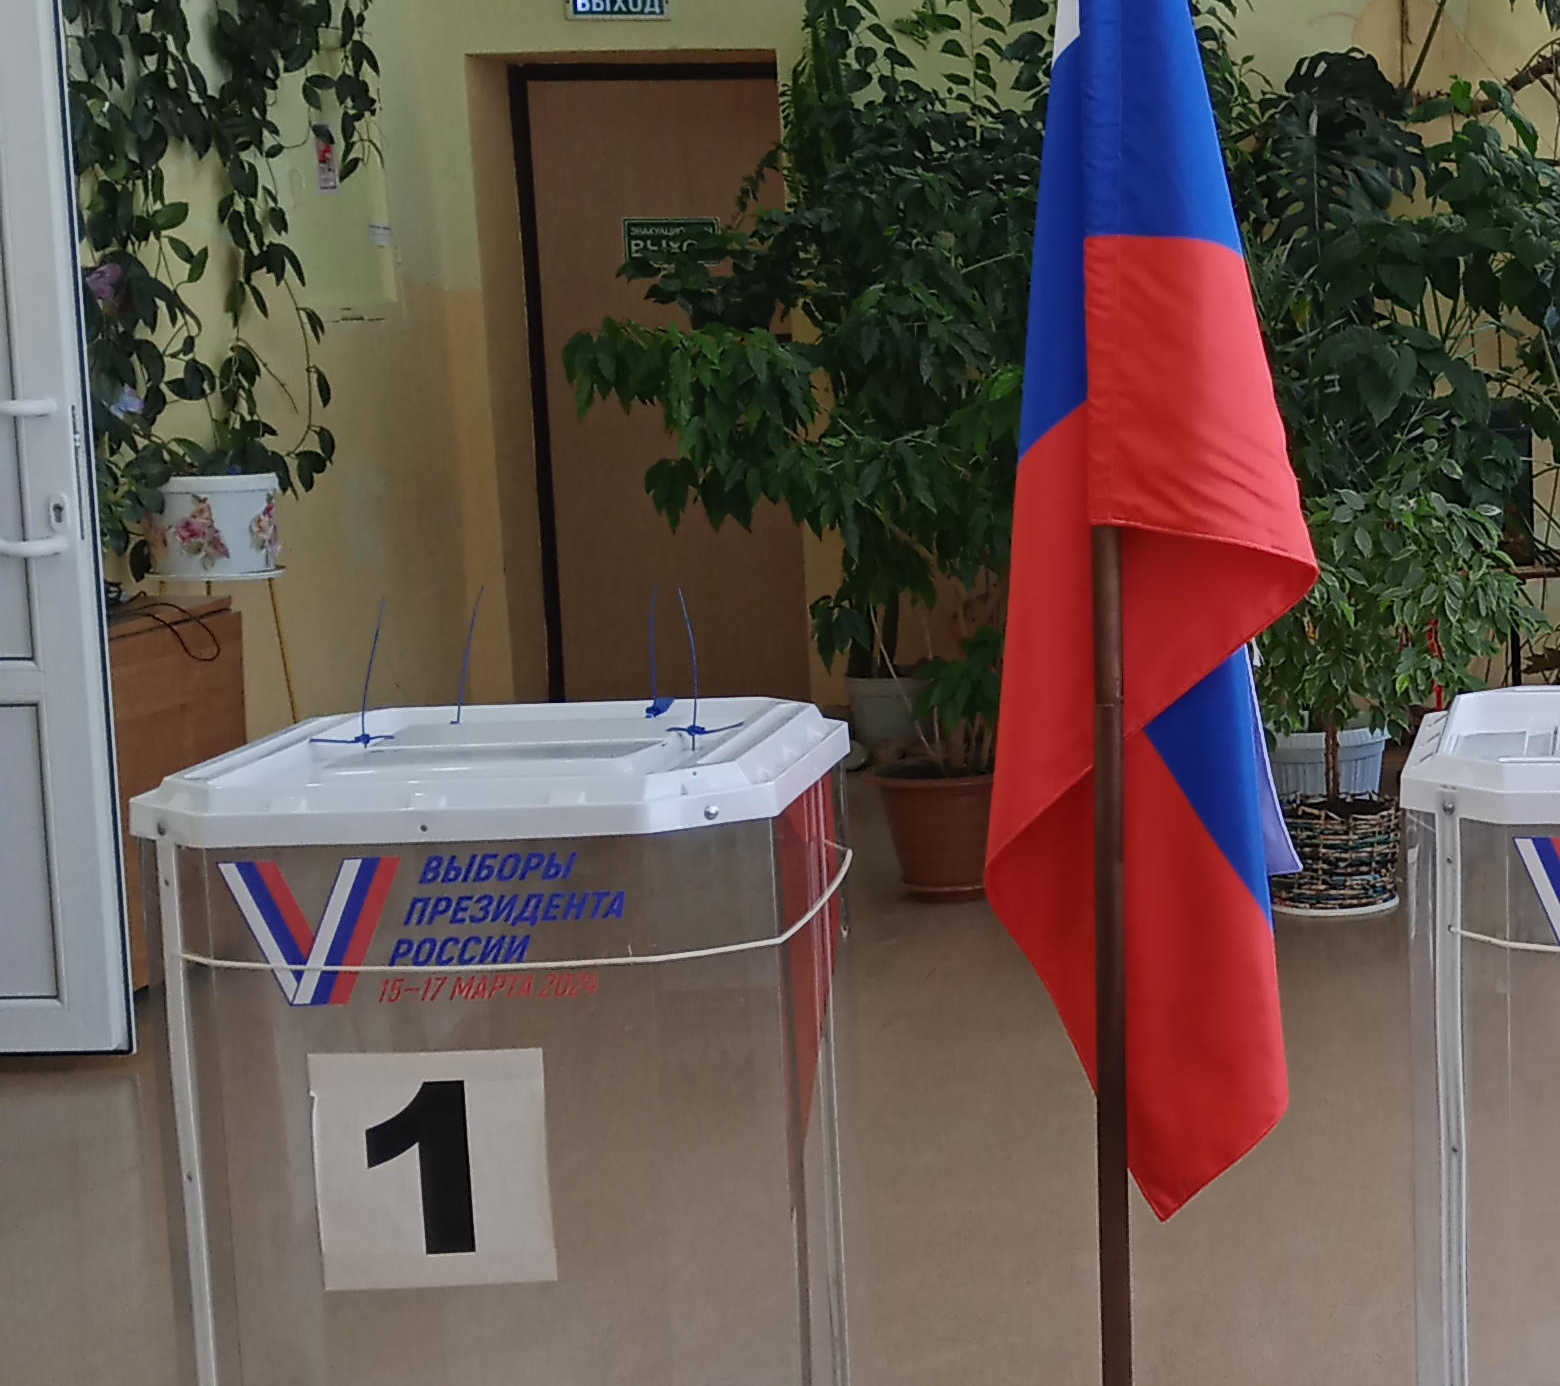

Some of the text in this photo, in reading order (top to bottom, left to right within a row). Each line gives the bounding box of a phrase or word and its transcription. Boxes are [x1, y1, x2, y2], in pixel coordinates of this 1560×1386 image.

[419, 852, 579, 885] ВЫБОРЫ
[403, 890, 626, 927] ПРЕЗИДЕНТА
[388, 935, 532, 967] РОССИИ
[449, 973, 534, 1001] МАРТА
[538, 971, 600, 999] 2024
[365, 1079, 476, 1255] 1
